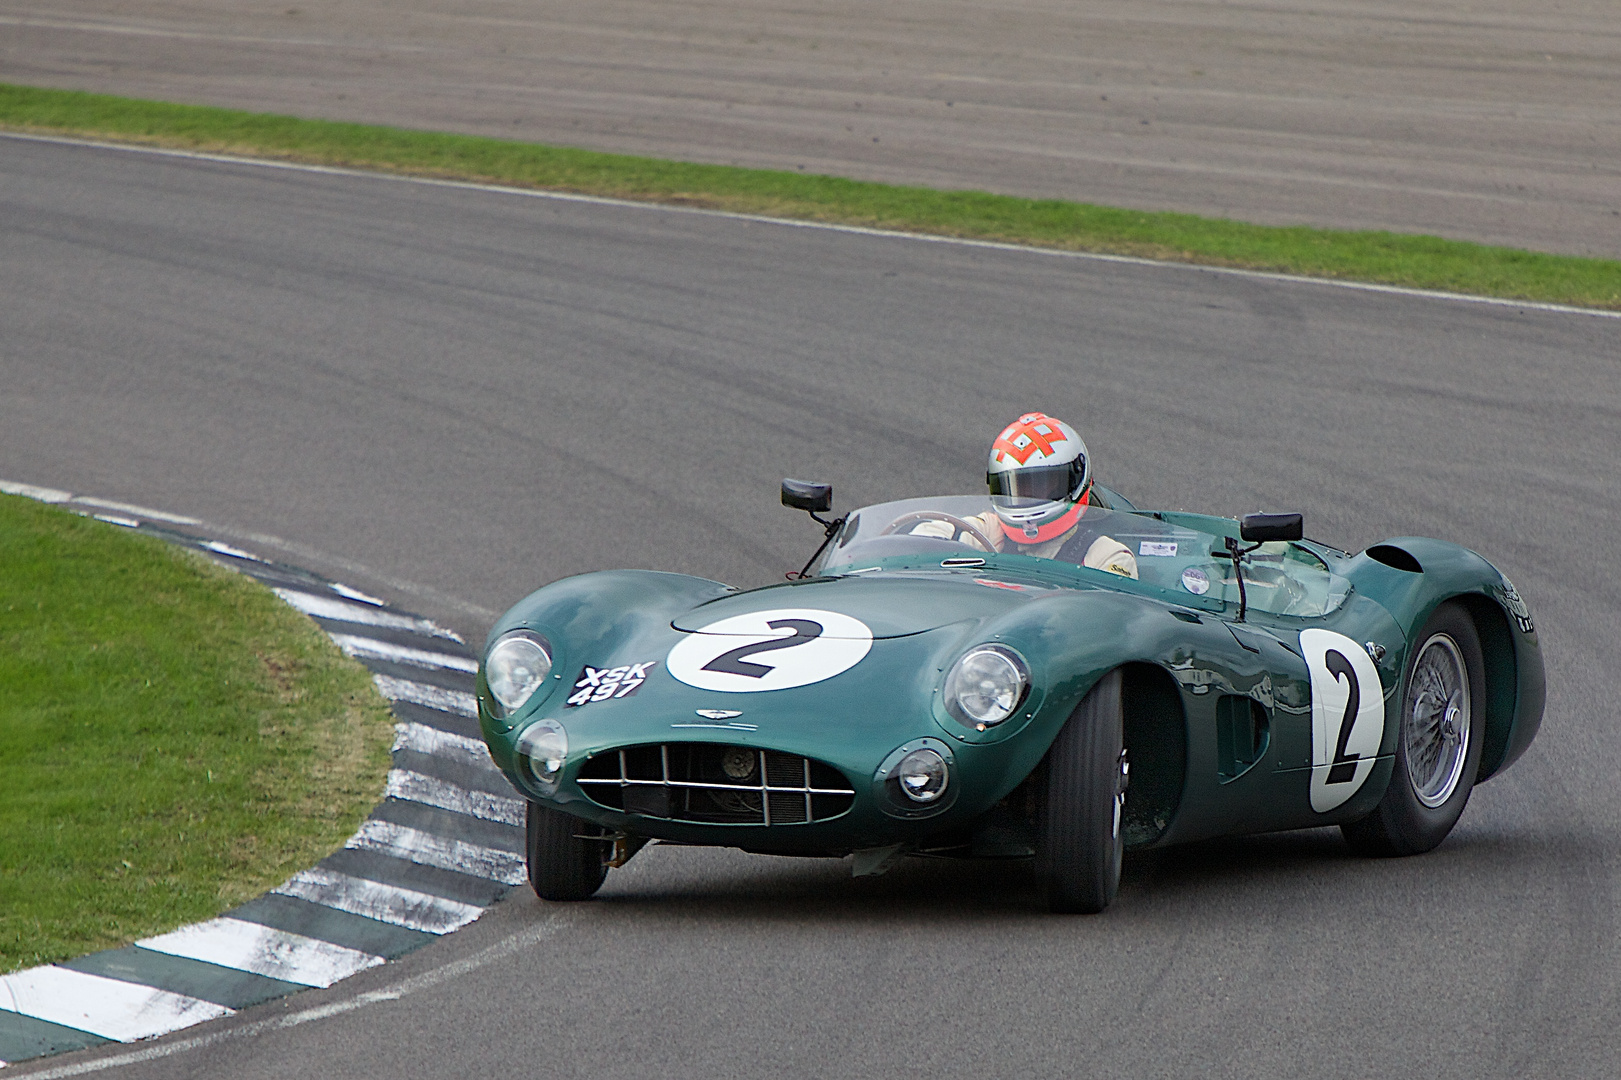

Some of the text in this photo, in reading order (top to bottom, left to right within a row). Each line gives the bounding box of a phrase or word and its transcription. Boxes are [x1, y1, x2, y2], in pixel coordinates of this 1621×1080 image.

[700, 618, 824, 678] 2
[566, 678, 645, 706] 497
[575, 661, 656, 687] XSK
[1325, 649, 1360, 785] 2
